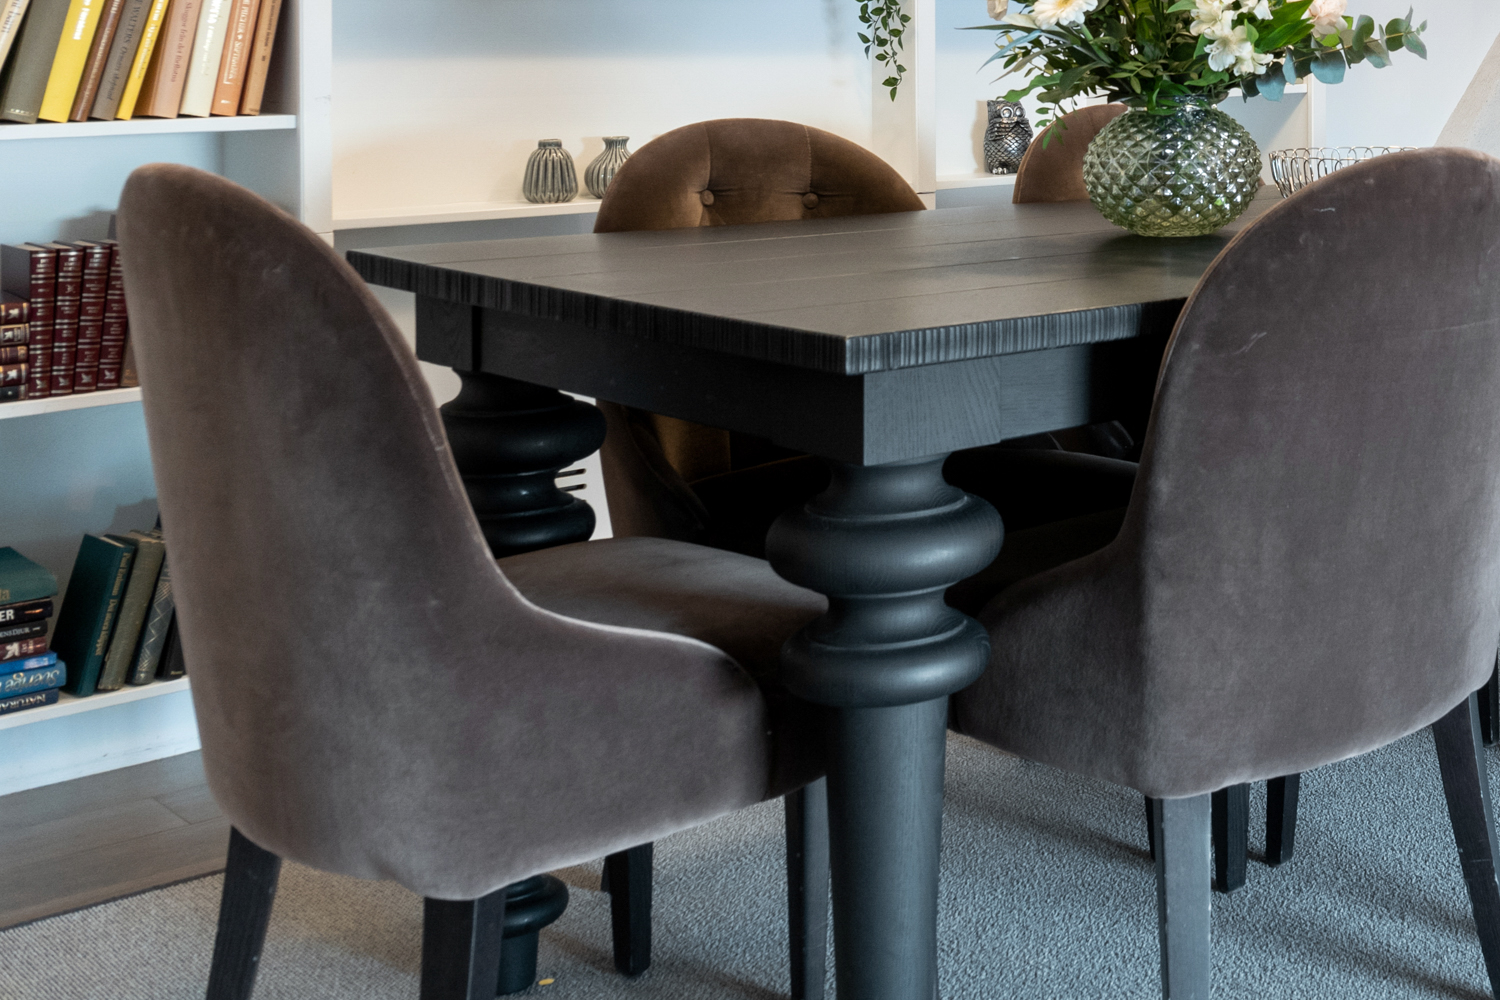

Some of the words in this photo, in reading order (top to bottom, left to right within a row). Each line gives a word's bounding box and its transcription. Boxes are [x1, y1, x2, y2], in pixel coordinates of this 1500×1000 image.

[124, 7, 141, 43] WALTERS
[181, 2, 193, 27] Skuggor
[5, 670, 59, 692] Sverige
